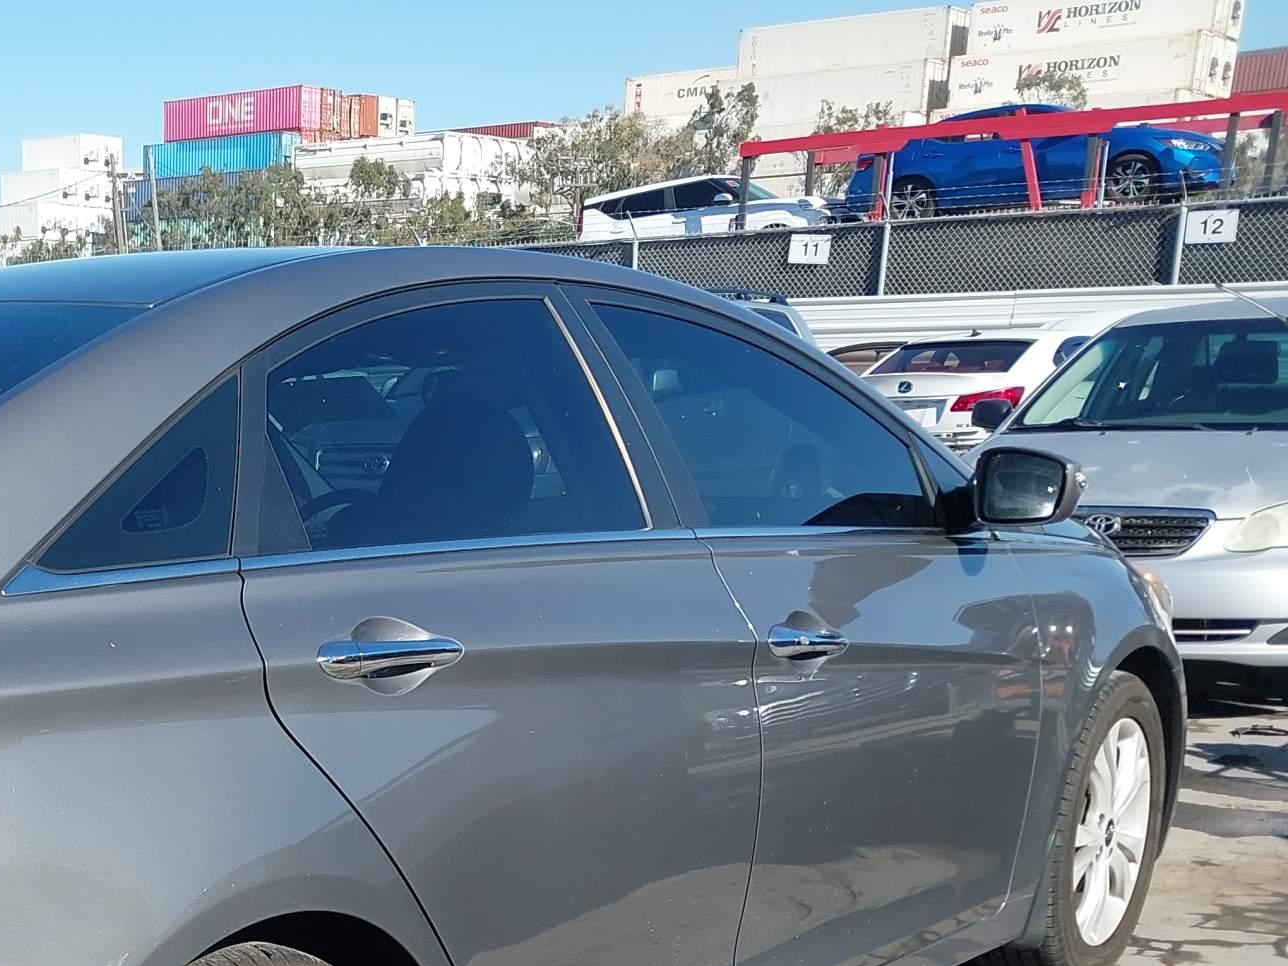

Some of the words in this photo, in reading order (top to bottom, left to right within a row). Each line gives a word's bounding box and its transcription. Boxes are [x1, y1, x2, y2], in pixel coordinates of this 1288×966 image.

[1066, 0, 1141, 18] HORIZON
[1064, 13, 1129, 28] LINES
[960, 58, 989, 68] seaco
[1046, 55, 1121, 73] HORIZON
[206, 96, 255, 126] ONE
[1200, 218, 1224, 235] 12
[802, 241, 819, 257] 11
